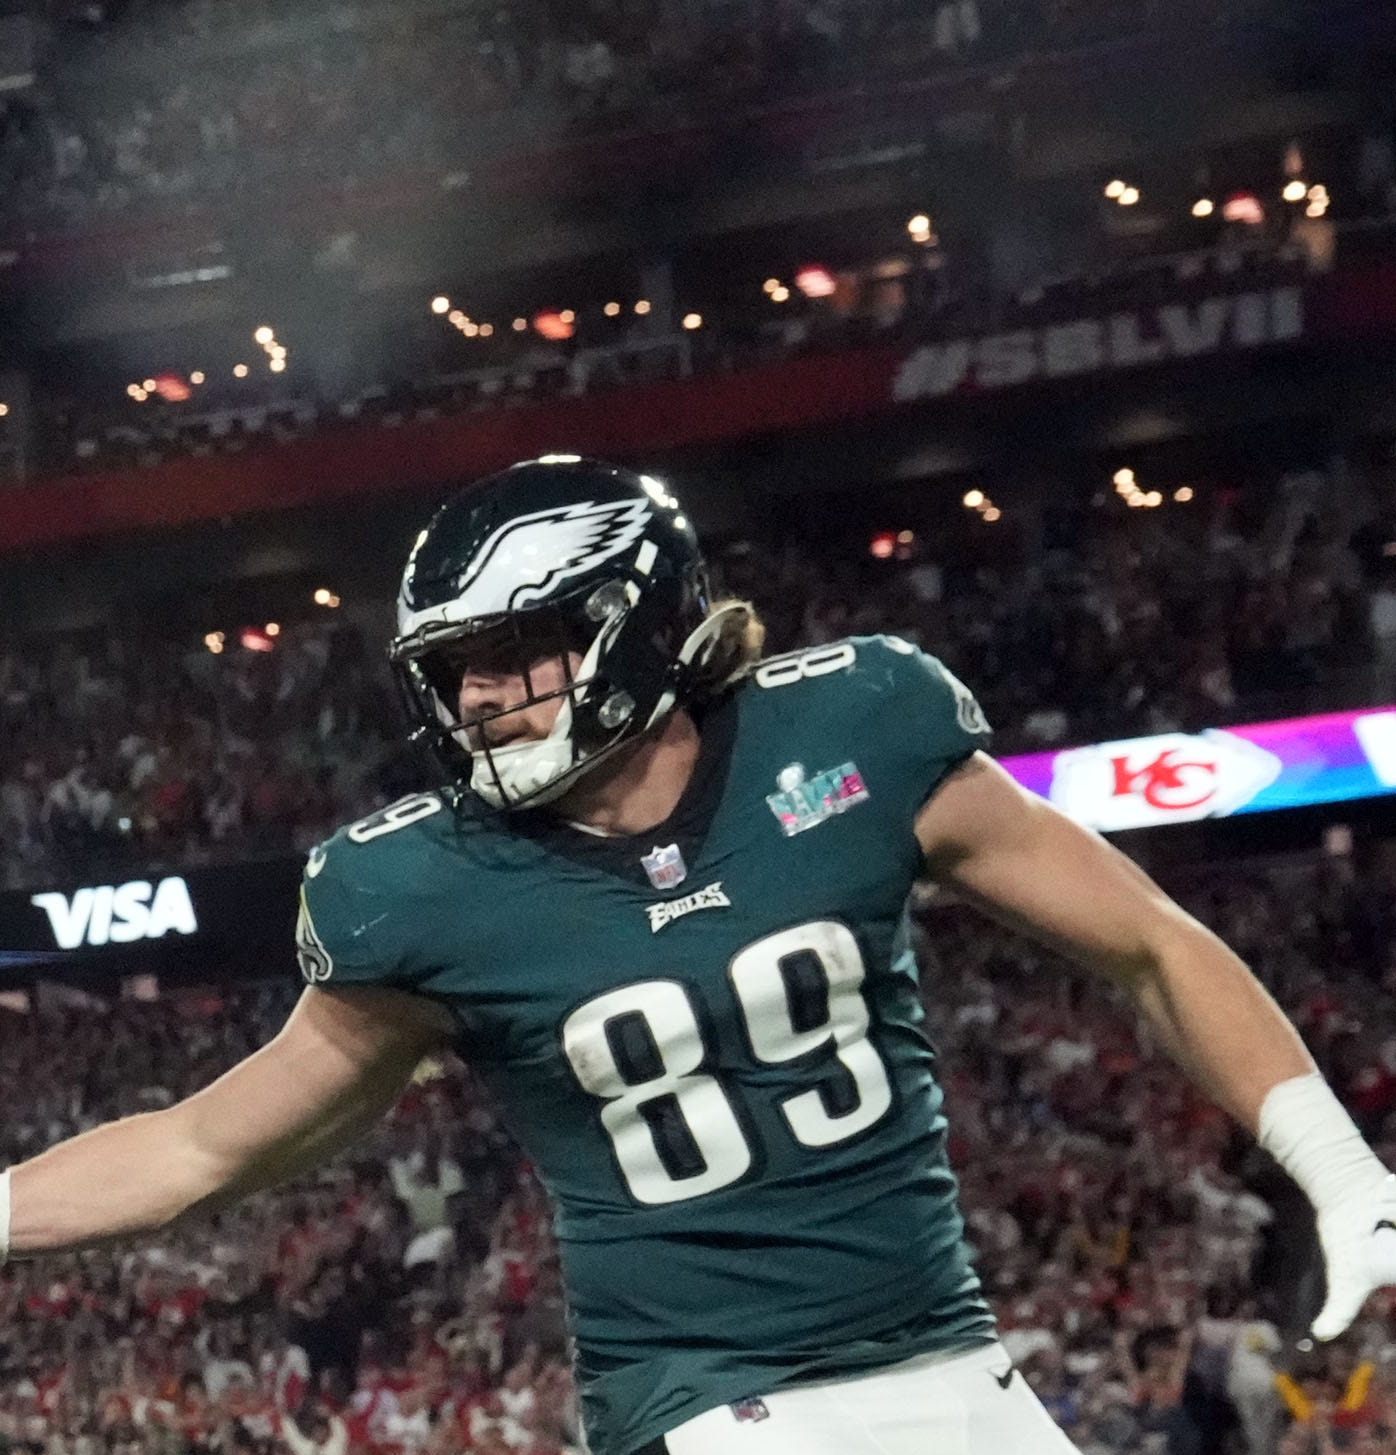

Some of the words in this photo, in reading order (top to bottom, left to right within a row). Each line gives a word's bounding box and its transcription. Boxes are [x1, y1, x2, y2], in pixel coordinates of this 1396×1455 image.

[894, 288, 1304, 402] #SBLVII
[1111, 748, 1217, 810] KC
[31, 876, 199, 950] VISA
[645, 881, 731, 934] EAGLES
[563, 921, 892, 1203] 89
